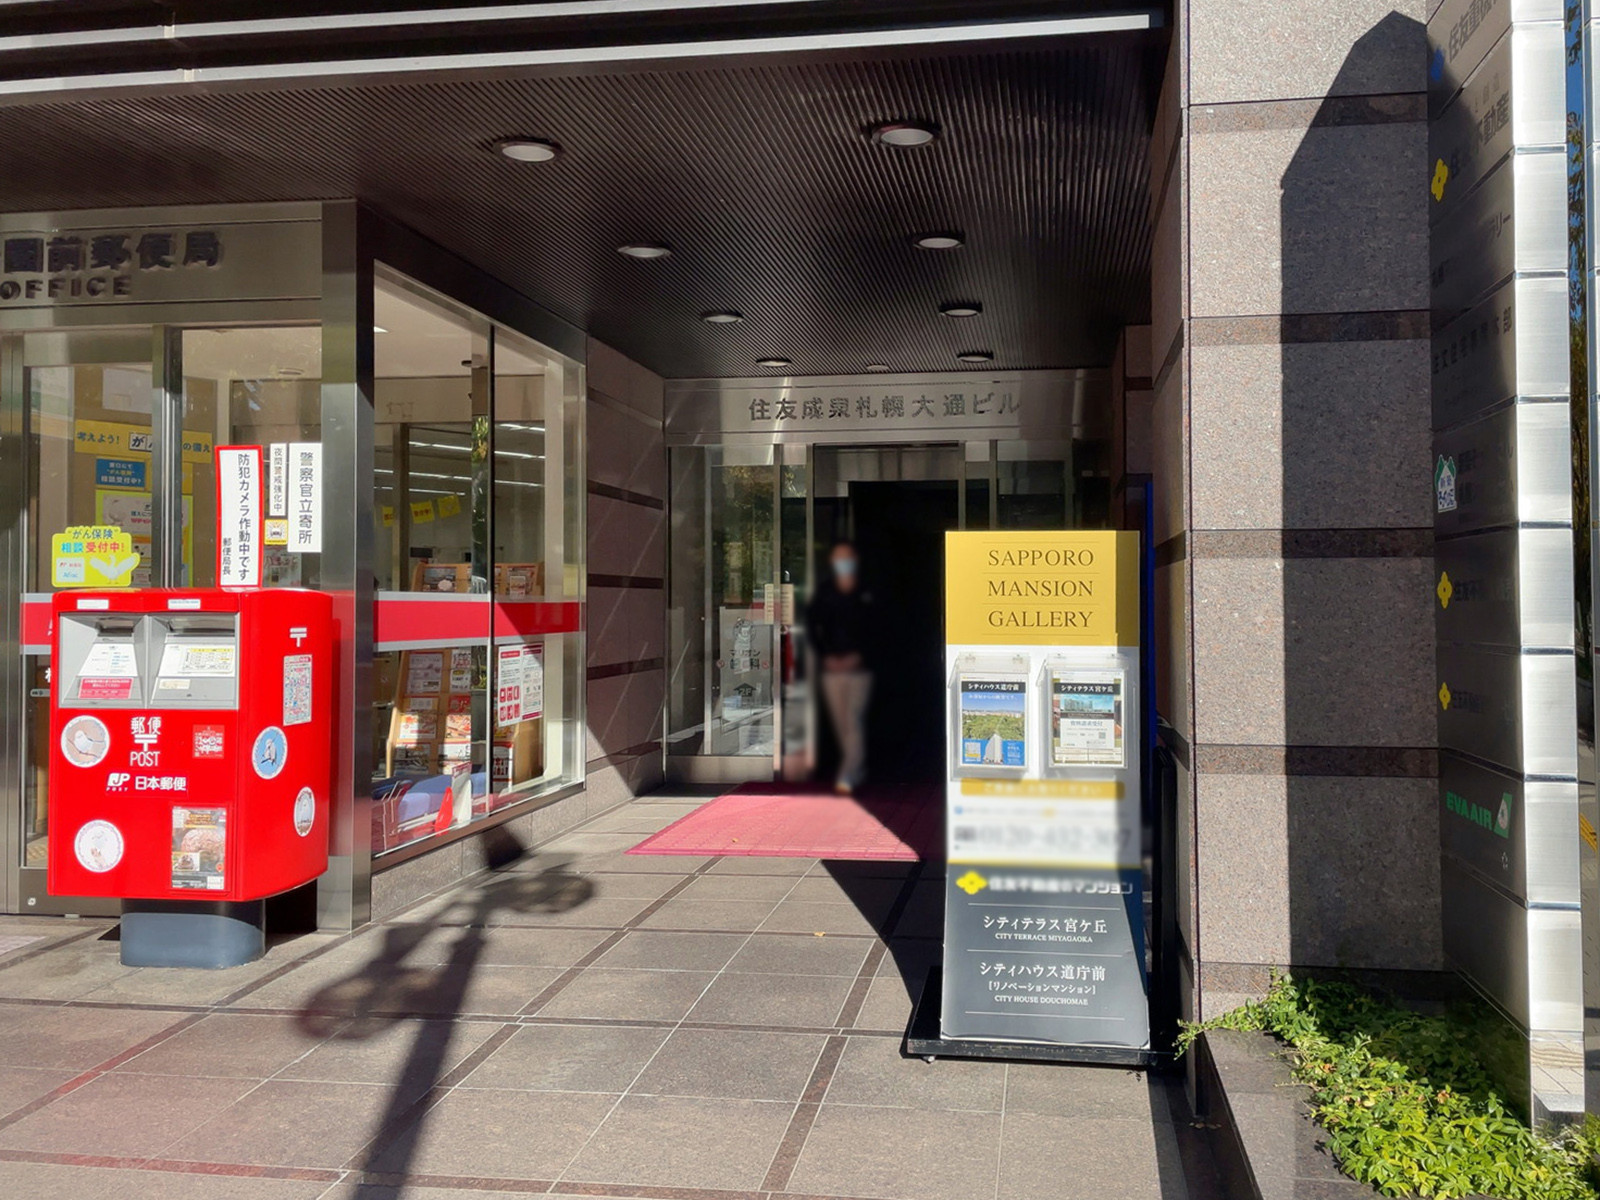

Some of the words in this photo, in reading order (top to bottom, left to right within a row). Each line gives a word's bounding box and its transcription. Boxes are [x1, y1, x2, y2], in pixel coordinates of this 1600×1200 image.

[0, 276, 131, 299] OFFICE
[298, 451, 314, 545] 警察官立寄所
[238, 453, 251, 581] 防犯カメラ作動中です
[222, 537, 232, 576] 郵便局長
[988, 549, 1094, 566] SAPPORO
[988, 580, 1093, 597] MANSION
[988, 610, 1093, 627] GALLERY
[130, 716, 161, 735] 郵便
[129, 751, 160, 766] POST
[135, 776, 186, 790] 日本郵便
[1446, 791, 1469, 819] EVA
[1470, 802, 1493, 831] AIR
[983, 915, 1107, 934] シティテラス宮ケ丘
[1014, 933, 1047, 942] TERRACE
[1048, 935, 1093, 943] MIYAGAOKA
[979, 962, 1106, 982] シティハウス道庁前
[994, 994, 1012, 1002] CITY
[1014, 995, 1039, 1004] HOUSE
[1040, 996, 1089, 1006] DOUCHOMAE
